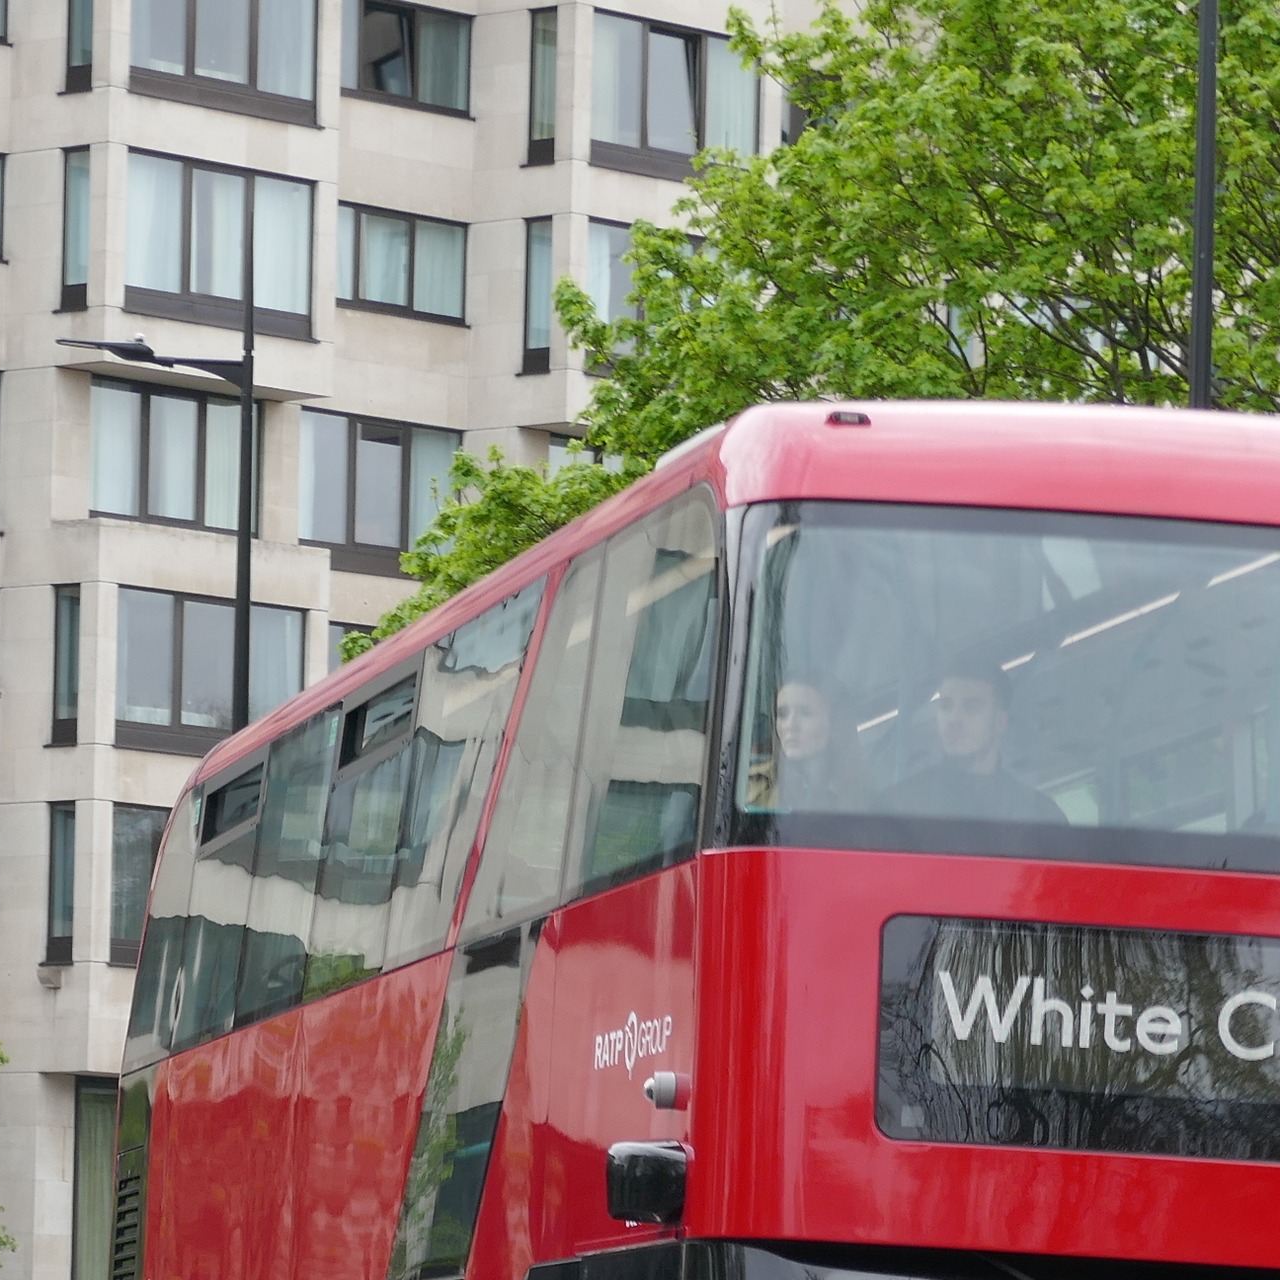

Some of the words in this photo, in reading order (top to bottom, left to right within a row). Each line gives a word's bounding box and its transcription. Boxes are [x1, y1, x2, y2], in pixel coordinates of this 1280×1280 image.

[594, 1029, 624, 1070] RATP
[638, 1015, 672, 1058] GROUP
[938, 971, 1181, 1055] White
